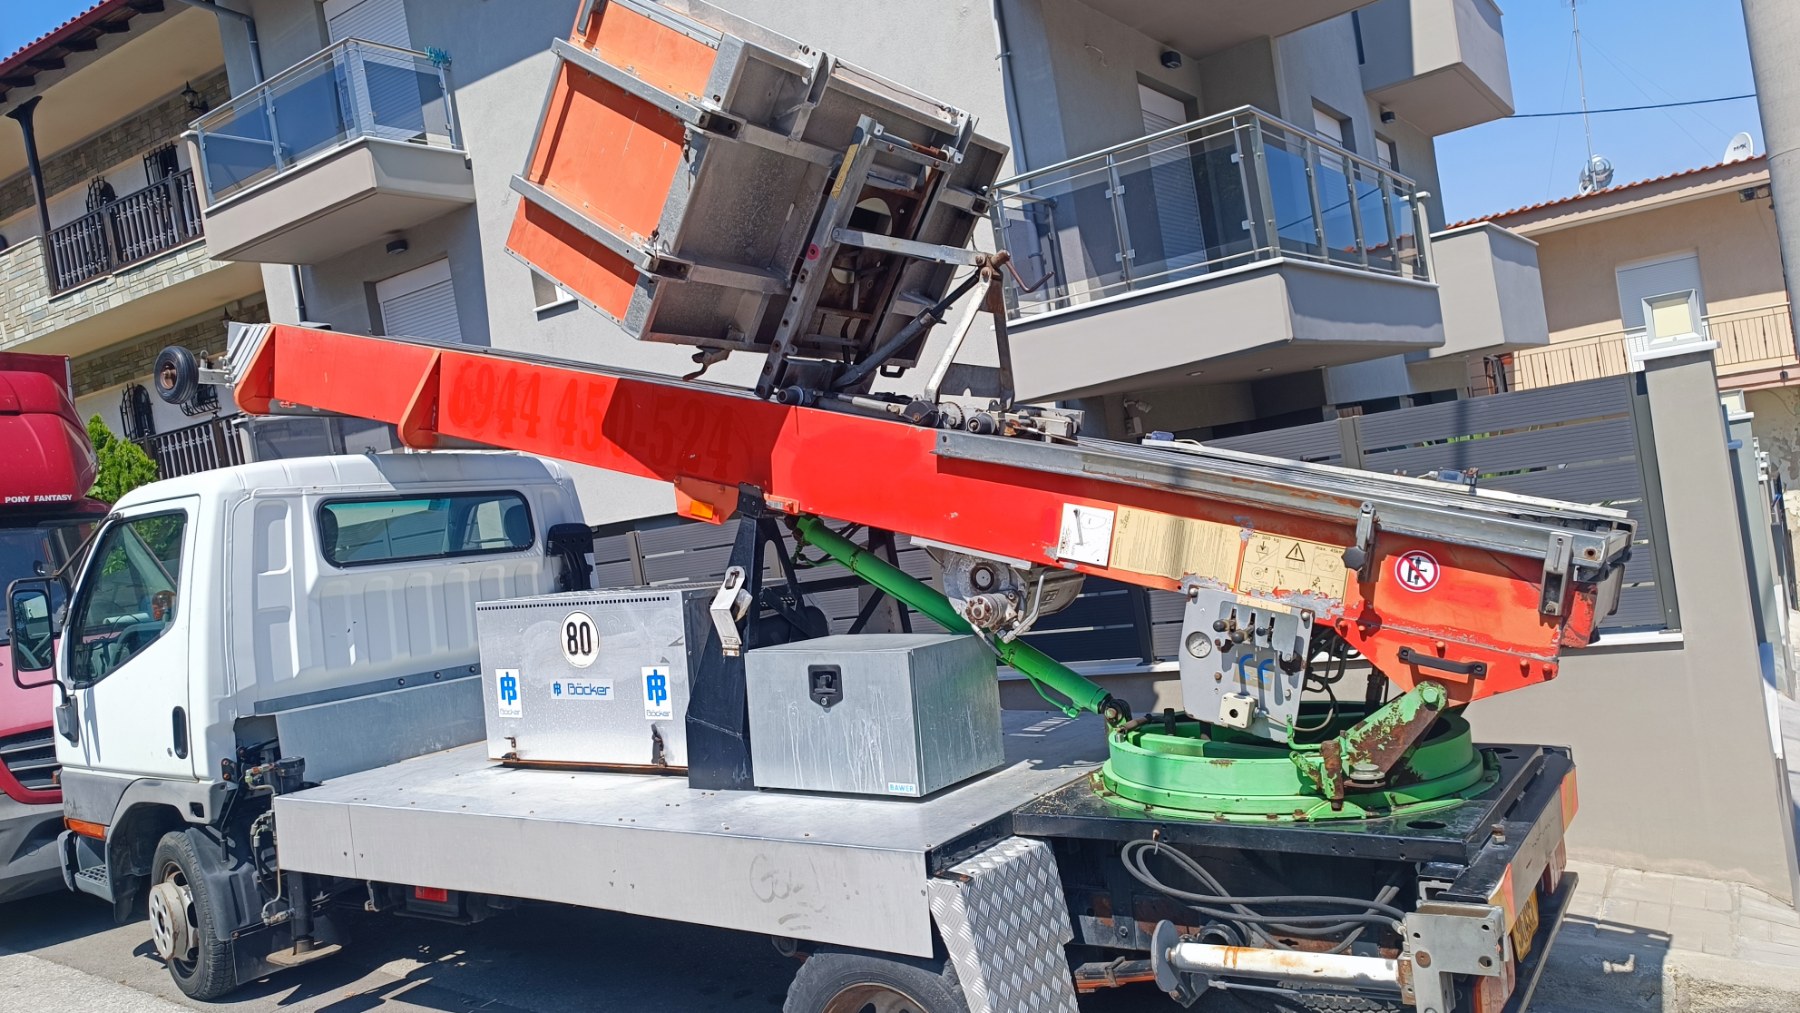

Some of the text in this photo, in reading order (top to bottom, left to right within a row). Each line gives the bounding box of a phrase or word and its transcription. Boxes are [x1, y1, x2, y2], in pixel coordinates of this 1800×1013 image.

[448, 359, 541, 438] 6944
[34, 494, 72, 502] FANTASY
[566, 621, 592, 656] 80
[567, 682, 611, 696] Böcker
[889, 784, 914, 792] BAWER
